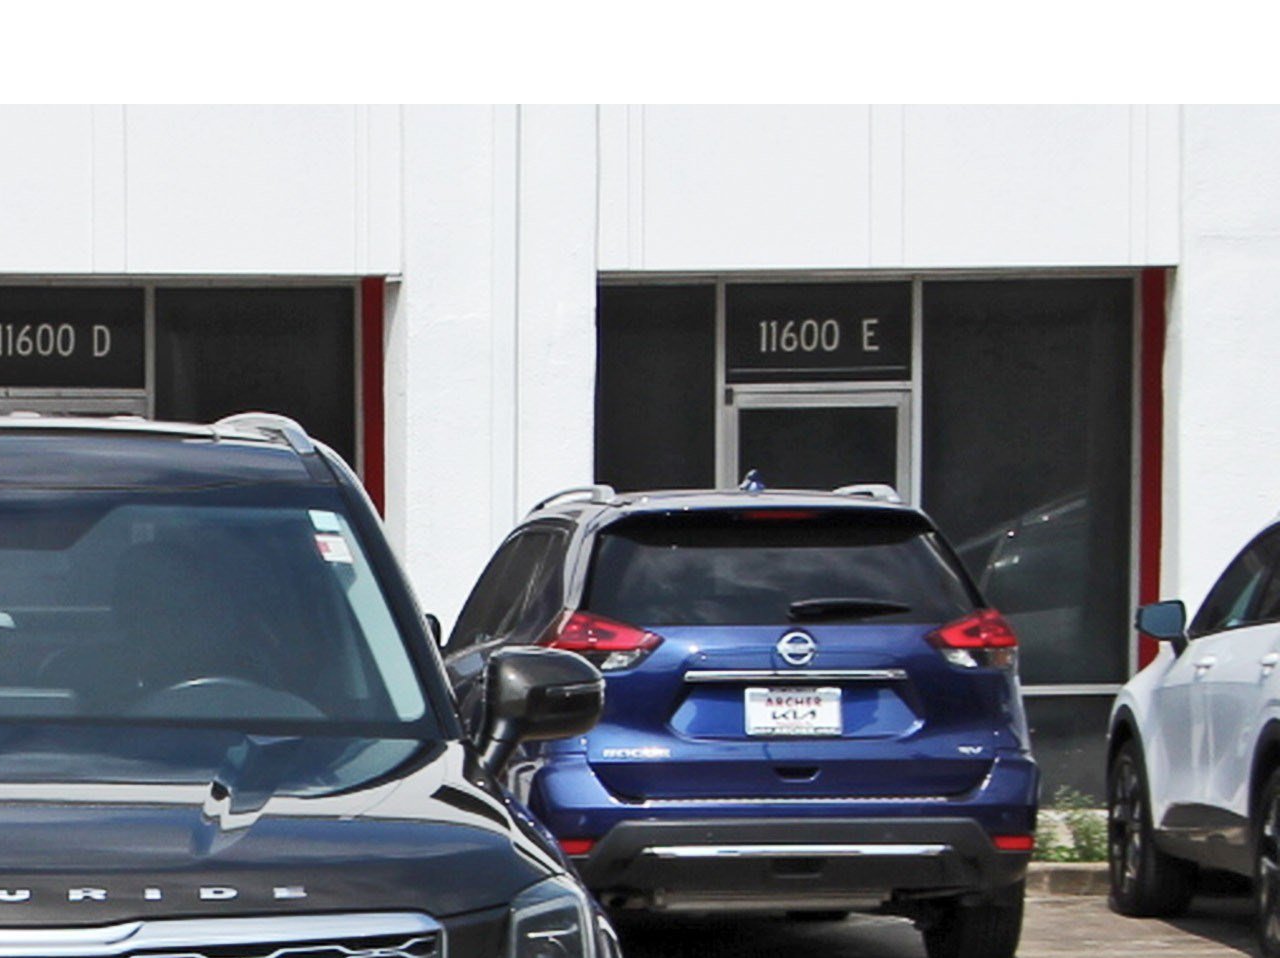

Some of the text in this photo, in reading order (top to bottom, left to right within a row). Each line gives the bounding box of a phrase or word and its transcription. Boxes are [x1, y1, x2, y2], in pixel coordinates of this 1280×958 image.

[93, 324, 111, 357] D
[759, 318, 880, 352] 11600 E
